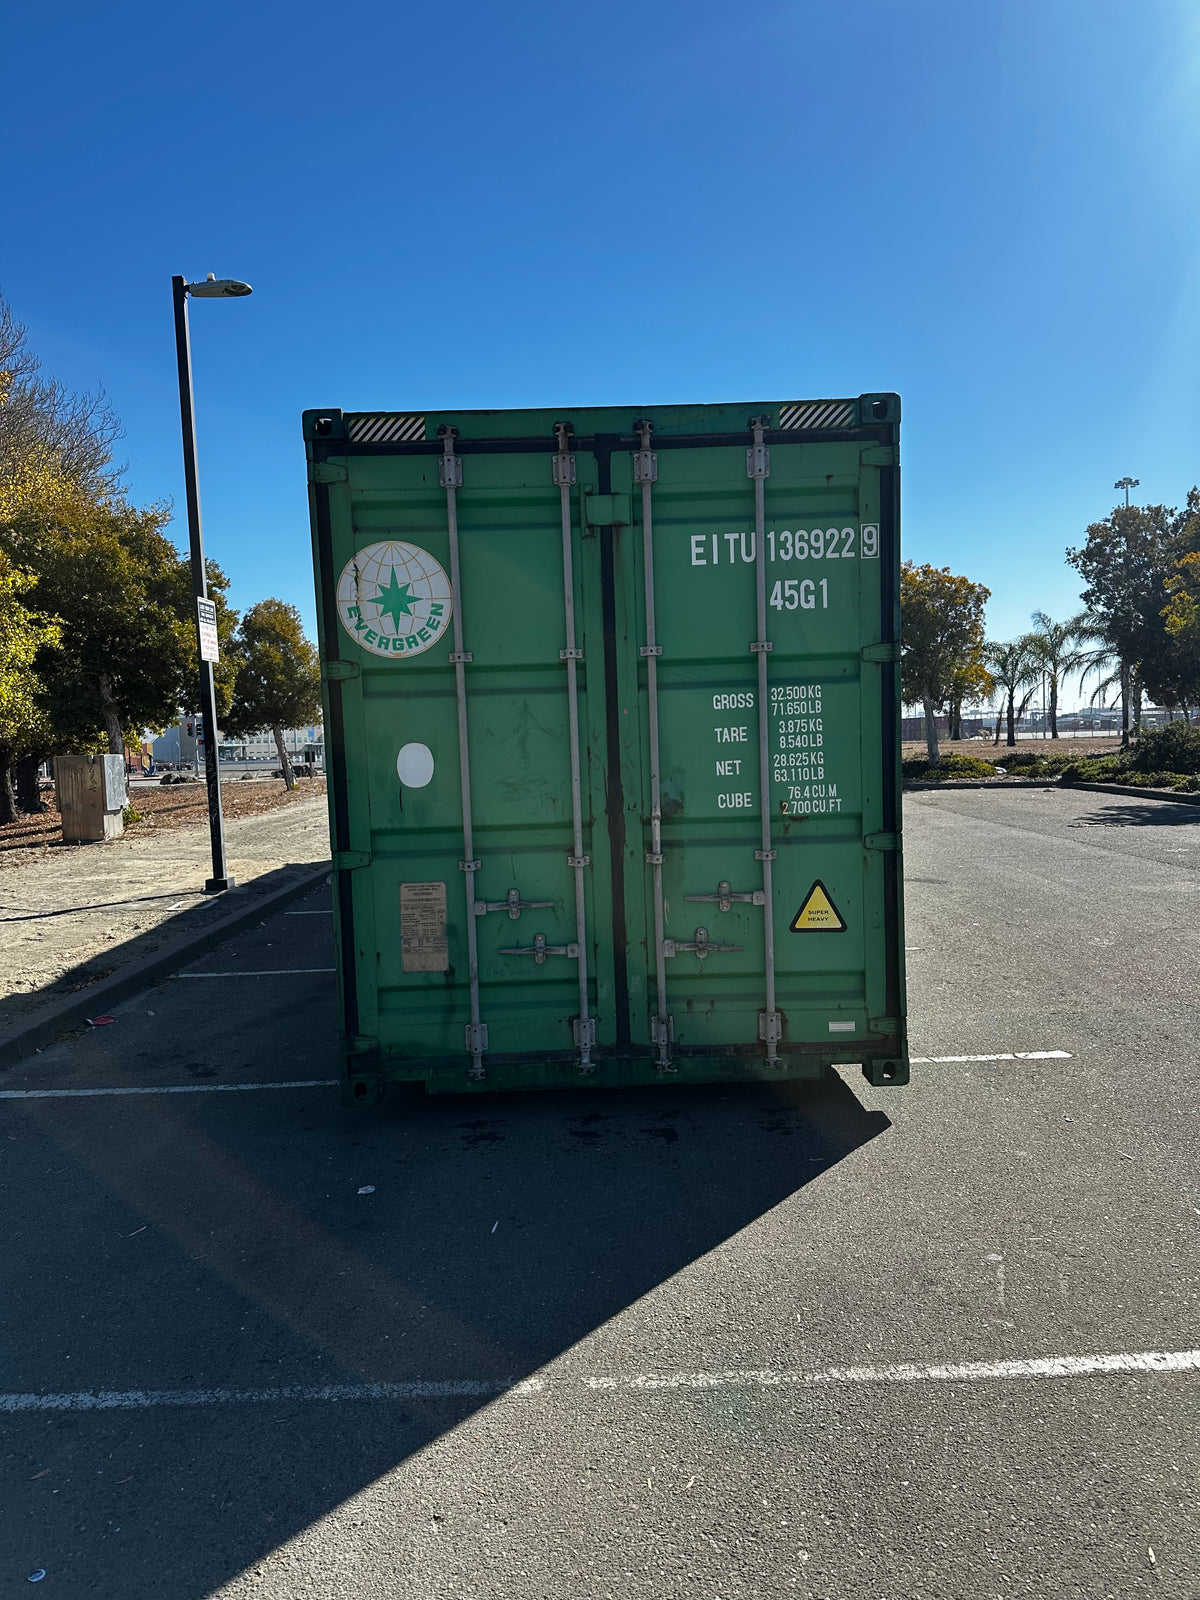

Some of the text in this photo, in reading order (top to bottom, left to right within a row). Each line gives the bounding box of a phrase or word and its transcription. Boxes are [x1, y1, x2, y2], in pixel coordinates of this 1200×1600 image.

[690, 525, 878, 566] EITU 136922 9
[769, 578, 829, 611] 45G1
[346, 602, 444, 651] EVERGREEN
[712, 692, 755, 710] GROSS
[714, 726, 748, 743] TARE
[716, 760, 742, 776] NET
[717, 792, 753, 809] CUBE
